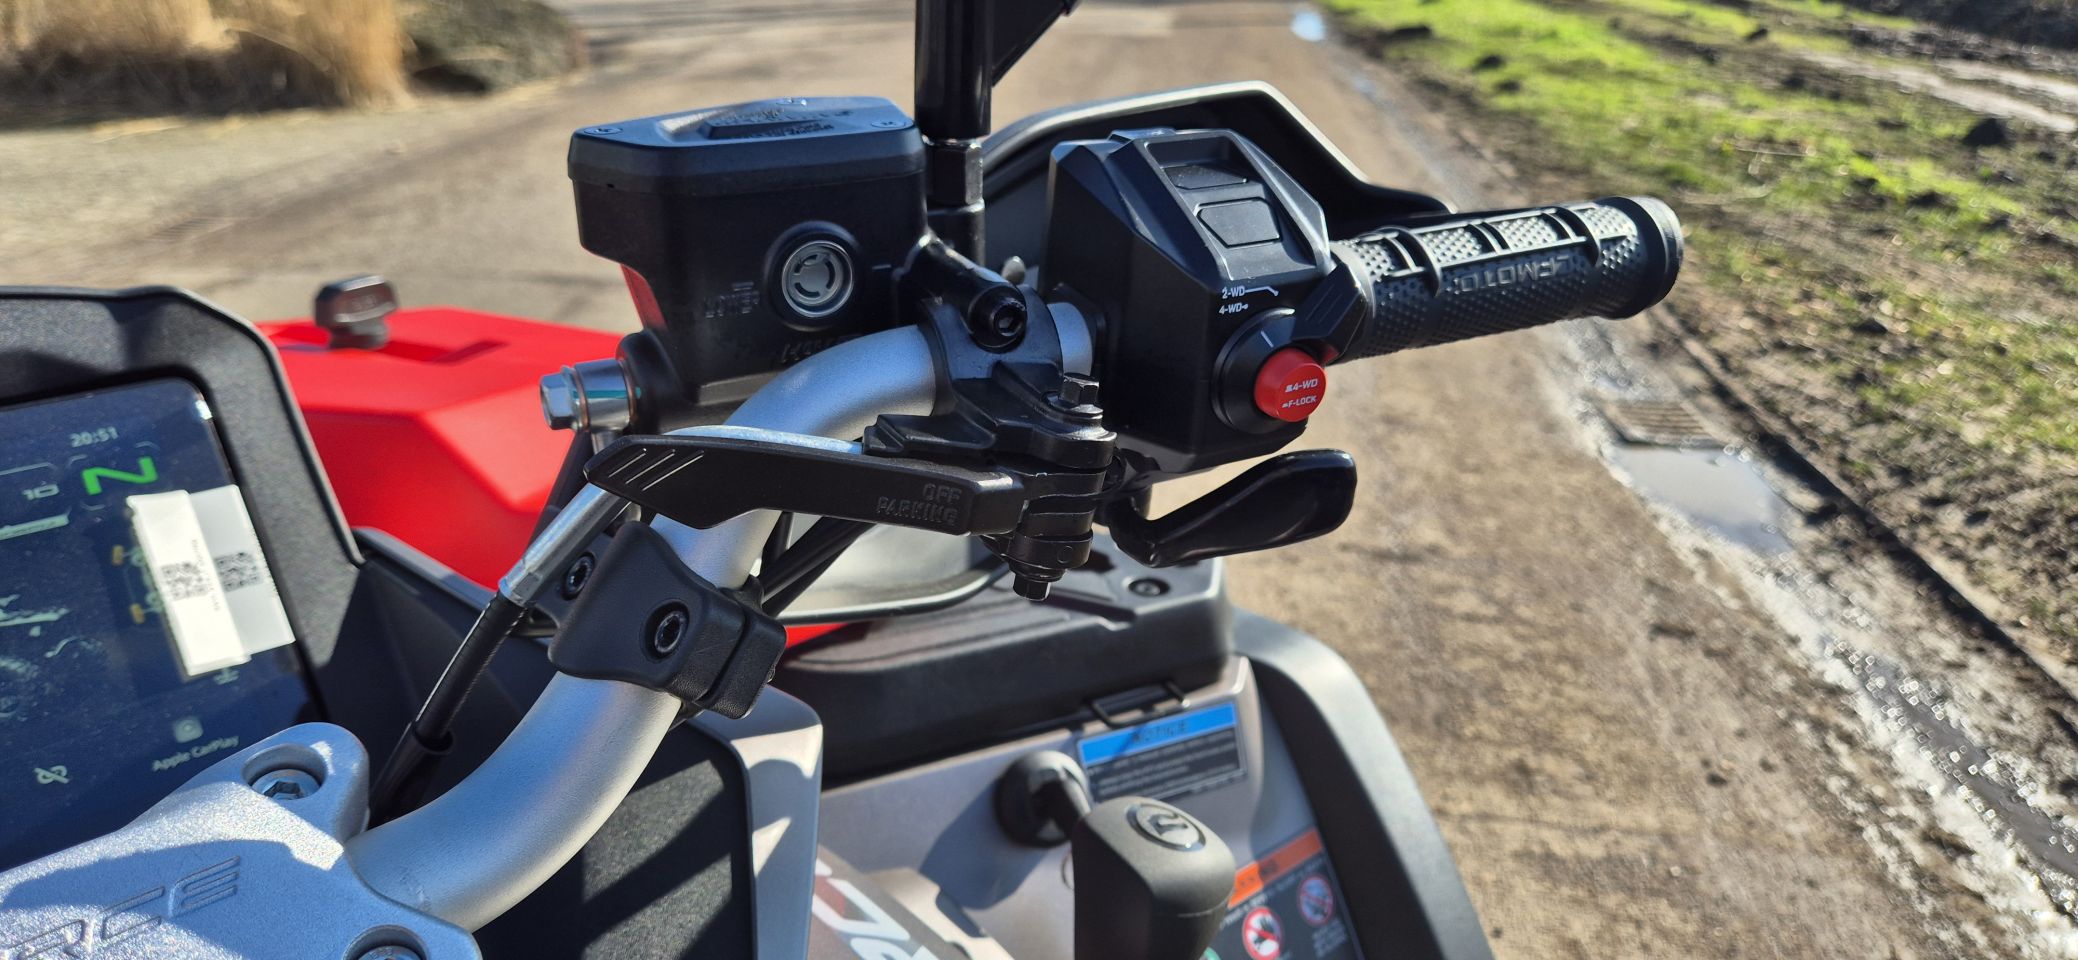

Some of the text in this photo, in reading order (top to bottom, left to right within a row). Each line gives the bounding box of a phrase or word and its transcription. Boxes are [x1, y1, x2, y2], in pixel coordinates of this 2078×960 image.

[1221, 285, 1246, 299] 2-WD
[1218, 302, 1243, 315] 4-WD
[69, 426, 119, 448] 20:51
[22, 483, 60, 501] 10
[922, 483, 963, 501] OFF
[876, 496, 960, 527] PARKING
[152, 735, 239, 772] Apple CarPlay
